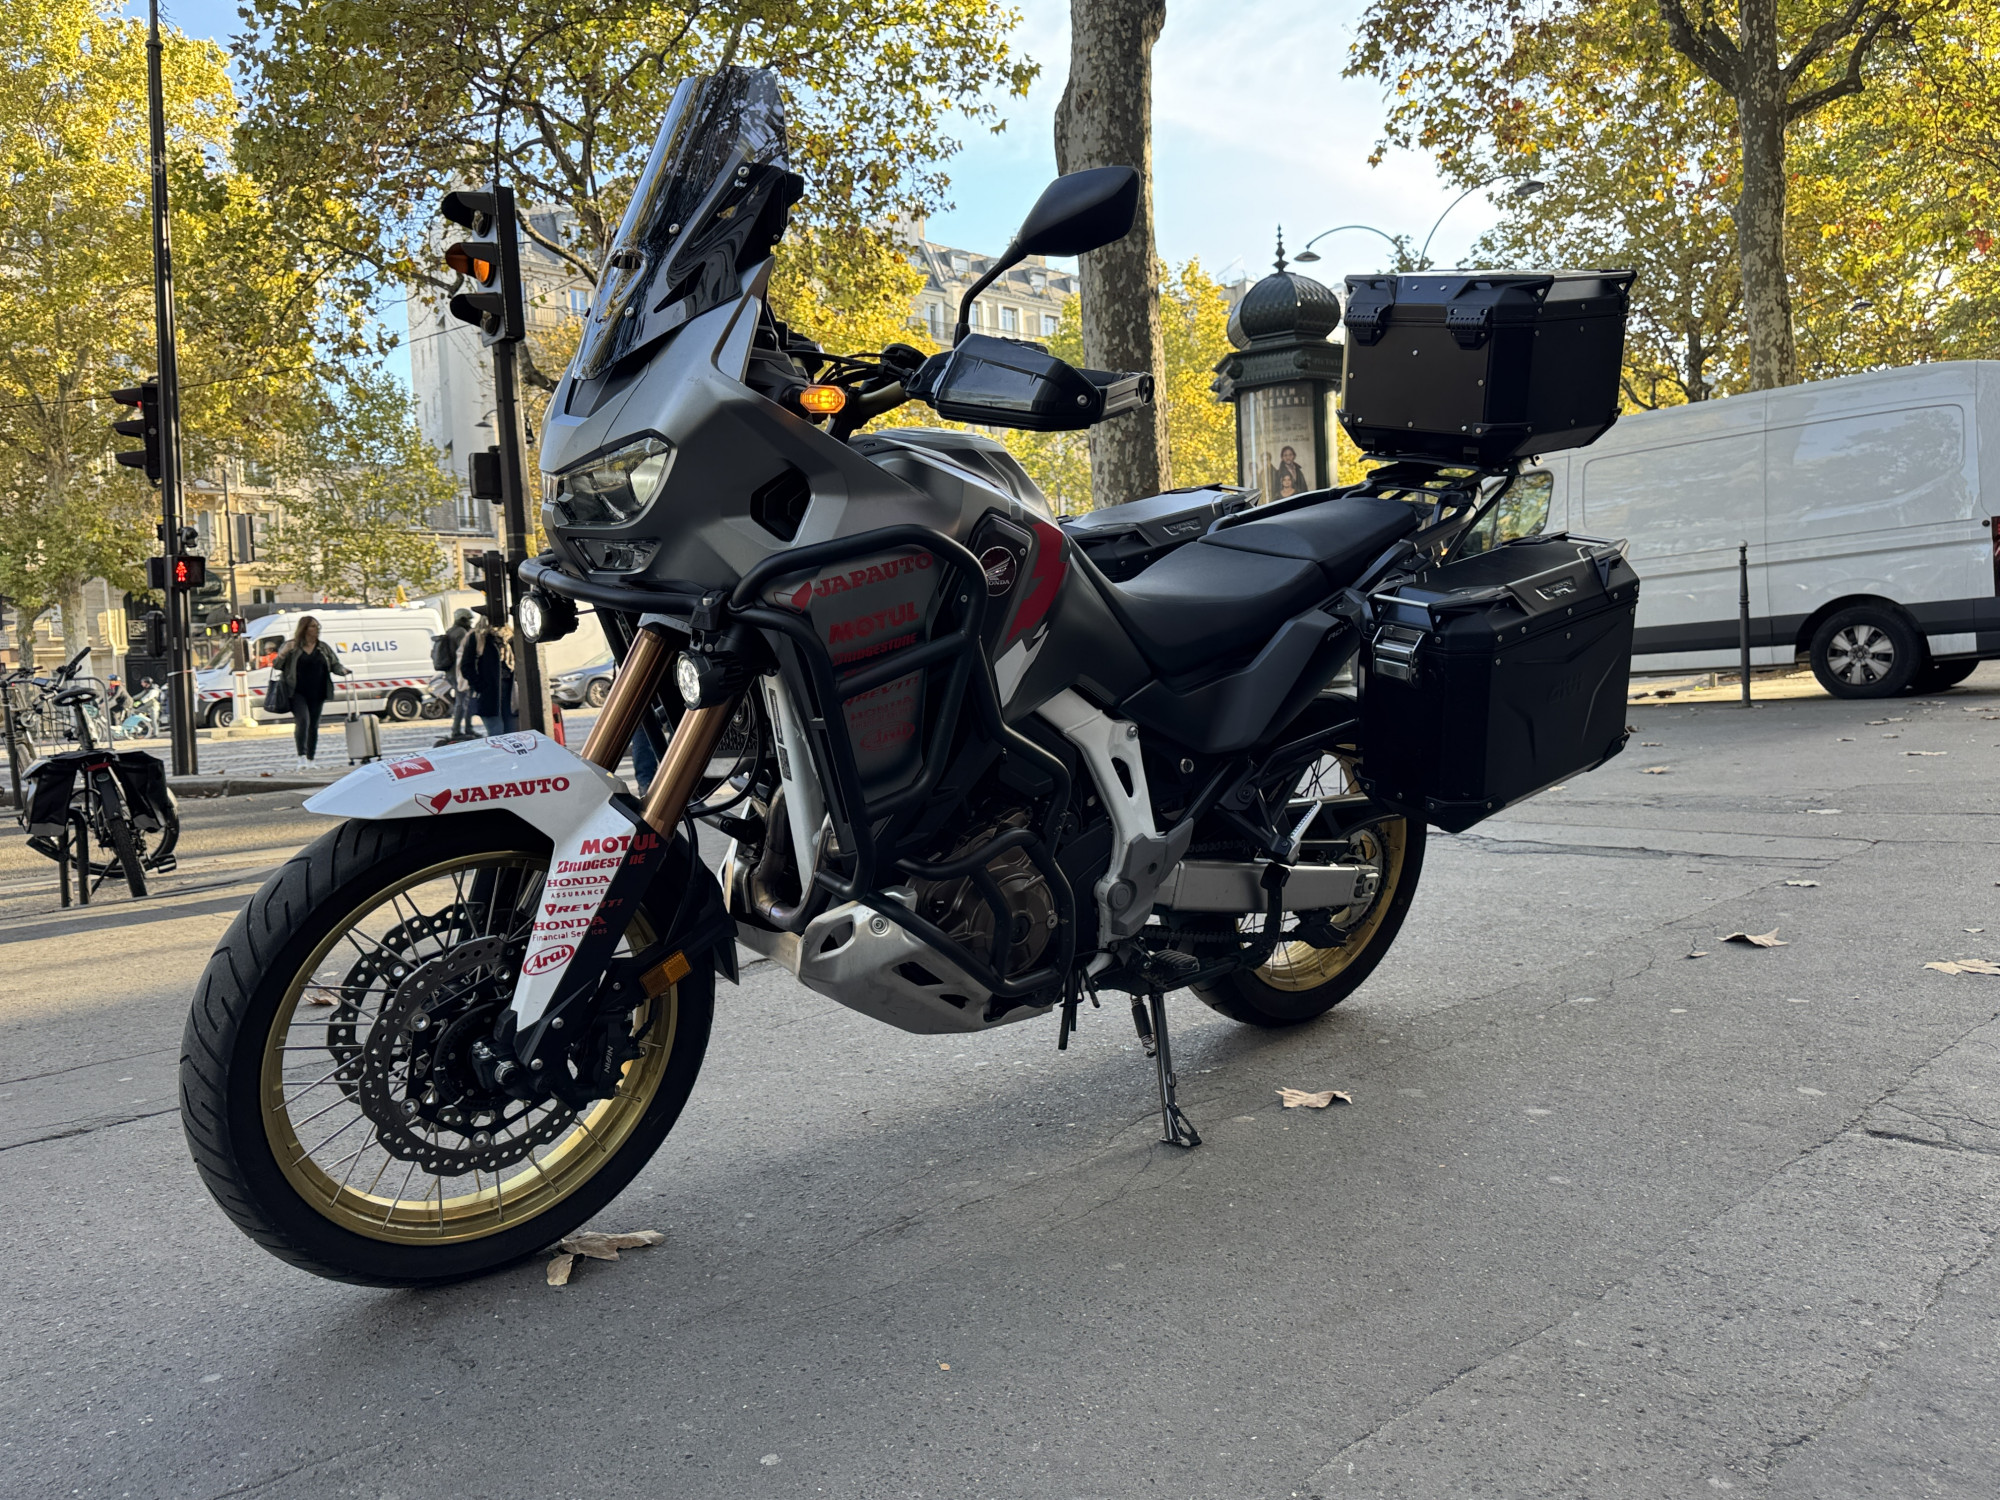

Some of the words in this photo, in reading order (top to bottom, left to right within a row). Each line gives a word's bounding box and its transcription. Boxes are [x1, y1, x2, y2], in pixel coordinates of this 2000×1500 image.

[813, 552, 934, 597] JAPAUTO
[828, 601, 919, 644] MOTUL
[351, 640, 398, 653] AGILIS
[453, 776, 570, 804] JAPAUTO
[579, 833, 660, 856] MOTUL
[555, 853, 646, 874] BRIDGESTNE
[547, 875, 612, 888] HONDA
[532, 916, 607, 931] HONDA
[532, 932, 569, 942] Financial
[571, 927, 608, 938] Serices
[528, 945, 569, 973] Arai
